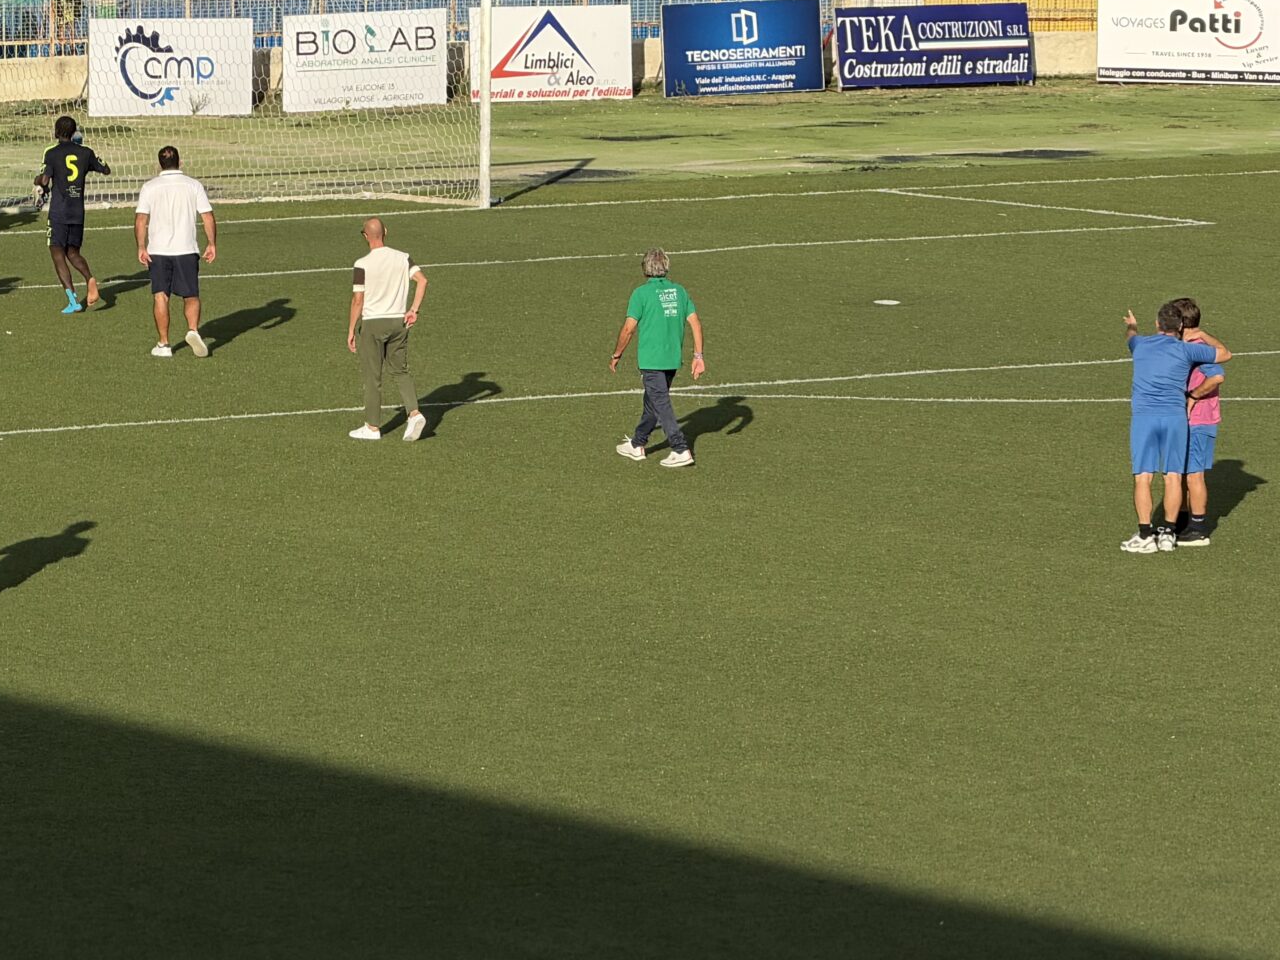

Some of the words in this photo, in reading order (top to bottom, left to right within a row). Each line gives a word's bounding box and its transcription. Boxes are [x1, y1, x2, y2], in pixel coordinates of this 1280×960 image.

[1111, 16, 1166, 29] VOYAGES
[1170, 9, 1242, 34] Patti
[837, 15, 920, 53] TEKA
[918, 20, 1003, 40] COSTRUZIONI
[296, 58, 358, 68] LABORATORIO
[361, 56, 395, 65] ANALISI
[397, 55, 437, 64] CLINICHE
[524, 52, 574, 70] Limblici
[686, 45, 806, 62] TECNOSERRAMENTI
[144, 57, 214, 84] cmp
[722, 62, 757, 70] SERRAMENTI
[844, 56, 927, 79] Costruzioni
[929, 54, 962, 76] edili
[964, 61, 973, 75] e
[976, 53, 1029, 74] stradali
[1100, 68, 1131, 77] Noleggio
[1146, 70, 1187, 78] conducente
[1211, 71, 1238, 79] Minibus
[565, 70, 594, 86] Aleo
[725, 75, 751, 83] industria
[771, 74, 796, 82] Aragona
[472, 88, 514, 99] Meriali
[517, 90, 524, 98] e
[526, 88, 569, 98] soluzioni
[572, 88, 589, 98] per
[65, 155, 79, 182] 5
